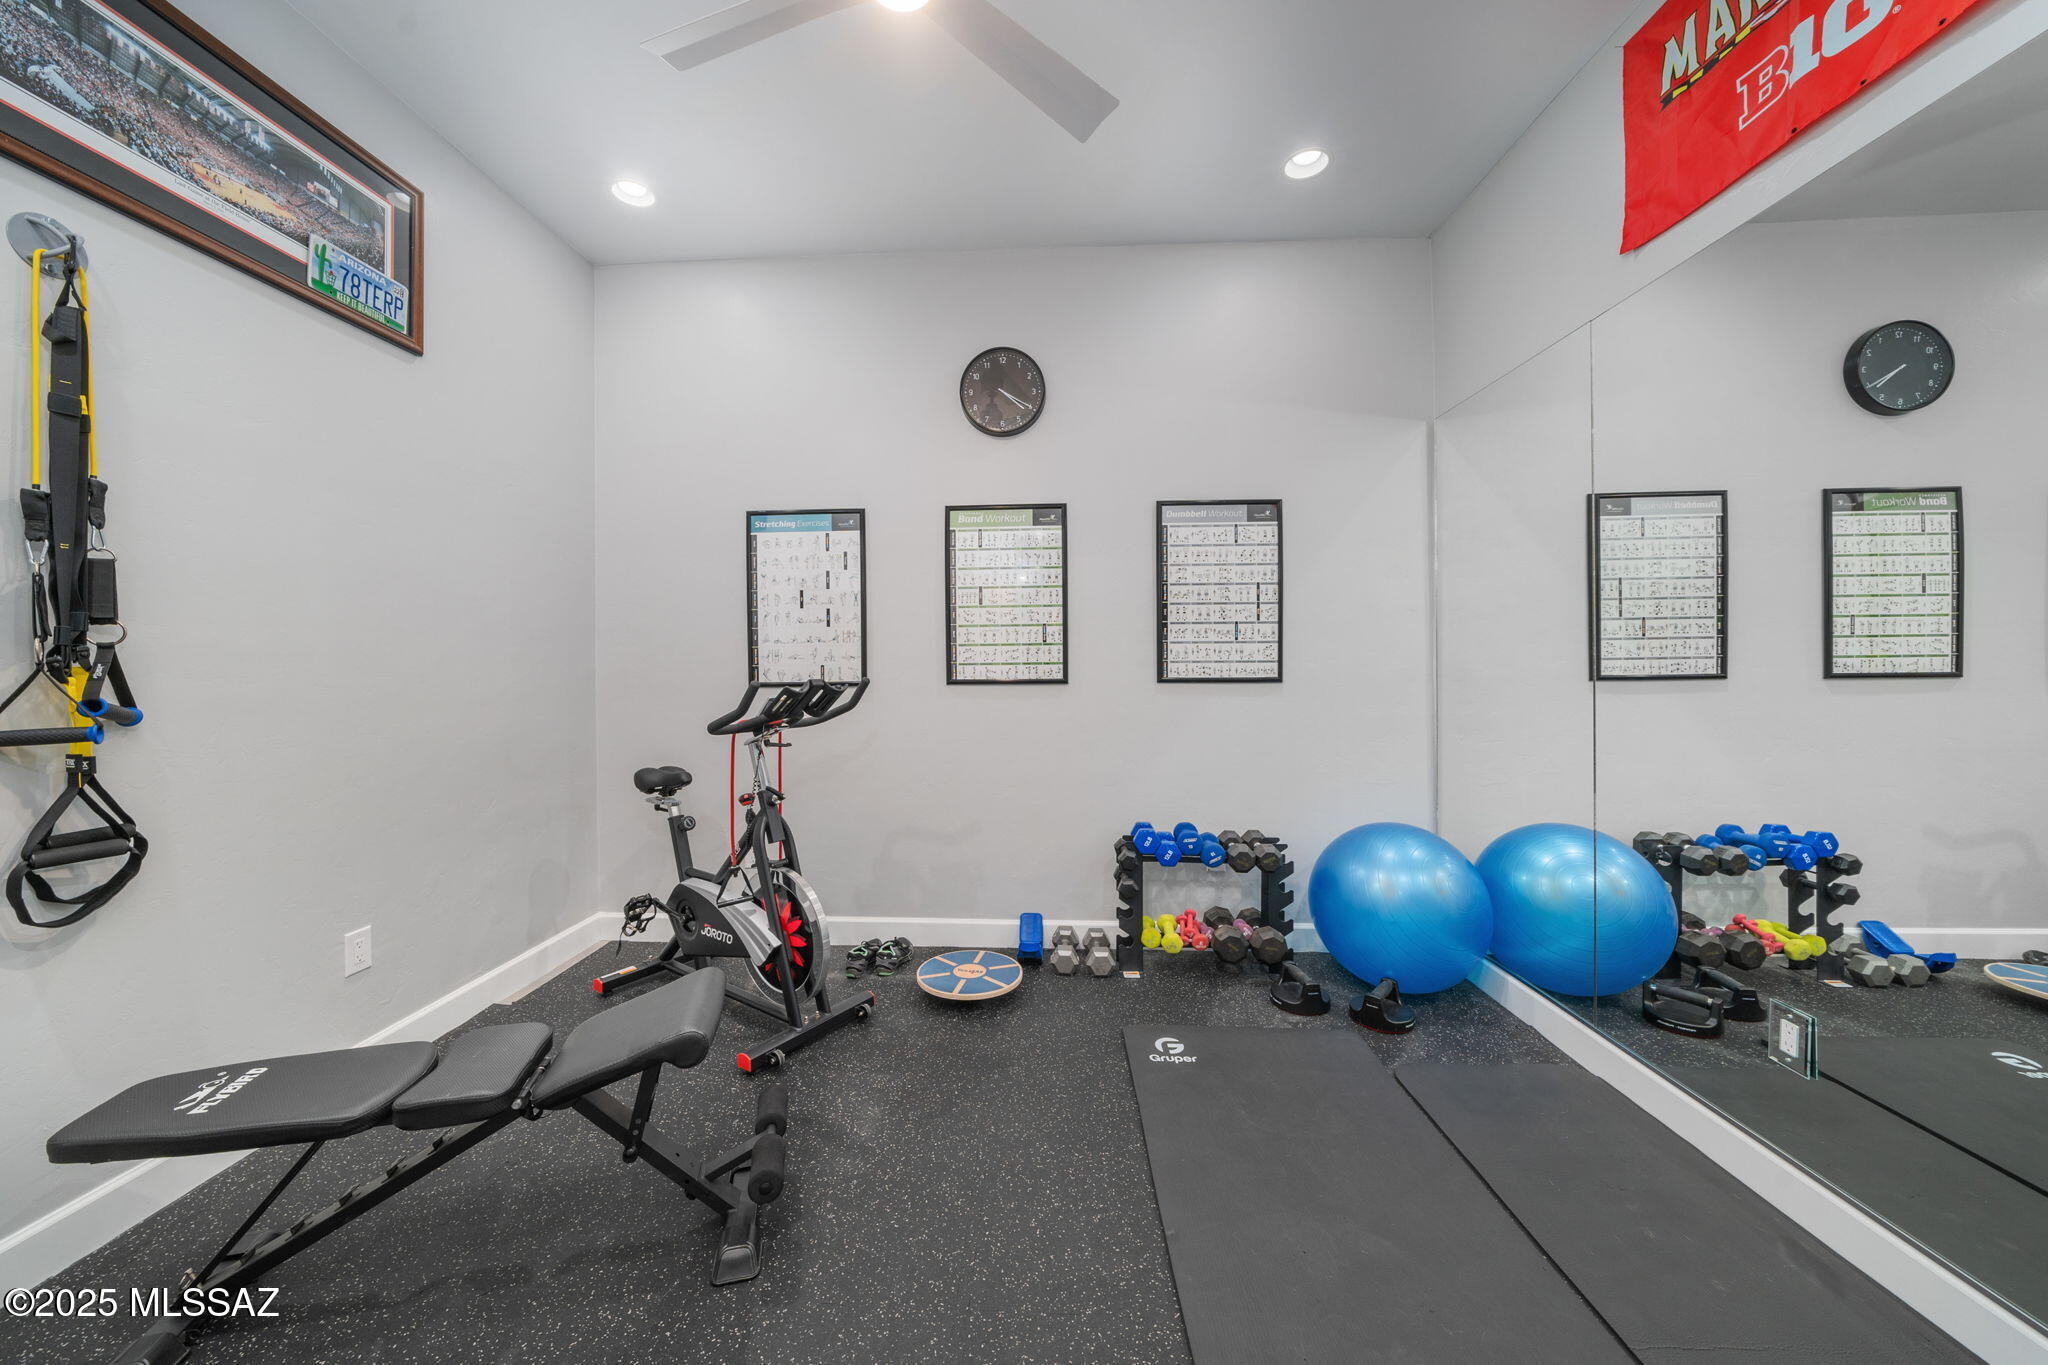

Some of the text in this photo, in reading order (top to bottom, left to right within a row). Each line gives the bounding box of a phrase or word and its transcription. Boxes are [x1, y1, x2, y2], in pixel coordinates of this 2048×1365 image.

[339, 254, 387, 286] ARIZONA
[339, 265, 404, 320] 78TERP
[336, 292, 351, 306] KEEP
[357, 303, 386, 323] BEAUTIFUL
[958, 513, 1026, 524] Band Workout
[1166, 509, 1243, 518] Dumbbell Workout
[754, 519, 796, 529] Stretching
[797, 519, 830, 528] Exercises
[1143, 836, 1153, 848] 12LB
[1163, 849, 1174, 861] 12LB
[701, 925, 733, 945] JOROTO
[1149, 1054, 1198, 1064] Gruper
[186, 1067, 268, 1115] FLYBIRD
